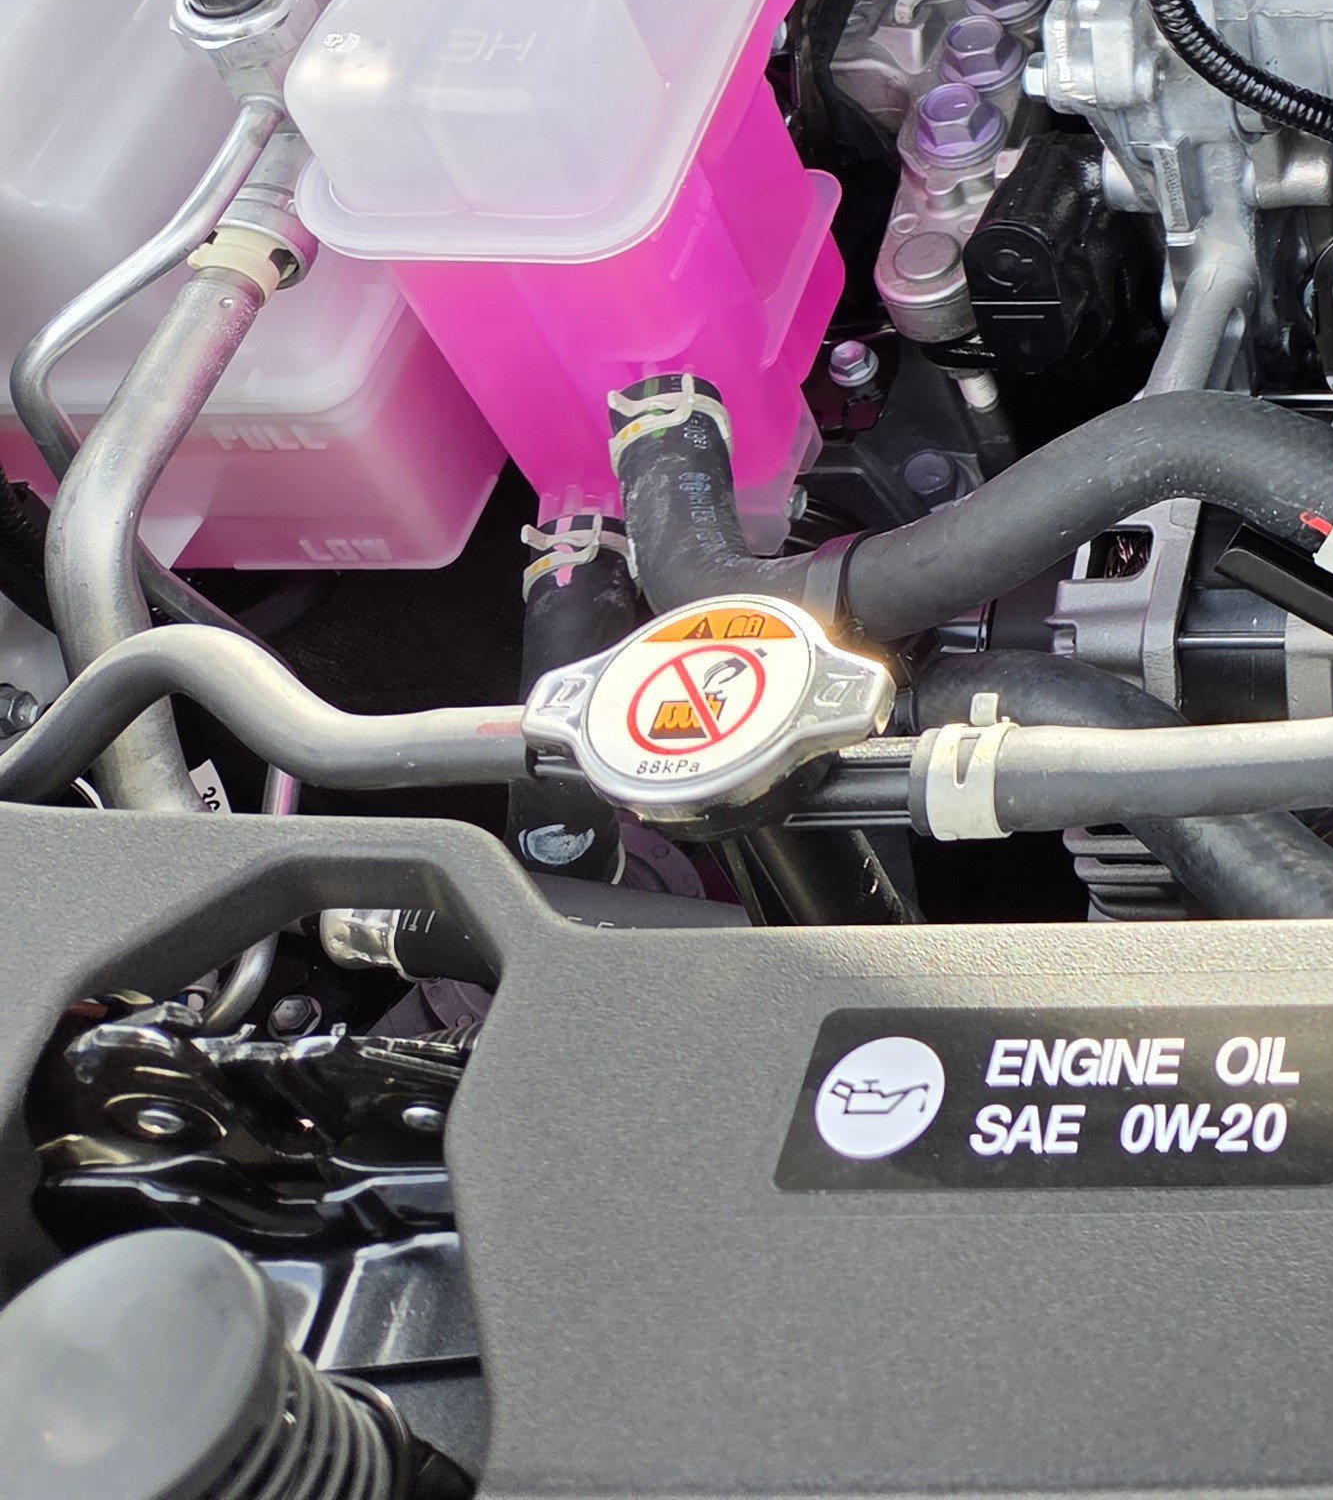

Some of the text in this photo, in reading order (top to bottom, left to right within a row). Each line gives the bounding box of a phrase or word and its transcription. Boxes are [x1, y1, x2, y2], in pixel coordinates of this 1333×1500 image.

[209, 425, 328, 450] FULL
[299, 538, 394, 562] LOW
[635, 759, 701, 775] 88kPa
[984, 1036, 1301, 1088] ENGINE OIL
[969, 1102, 1288, 1156] SAE 0W-20
